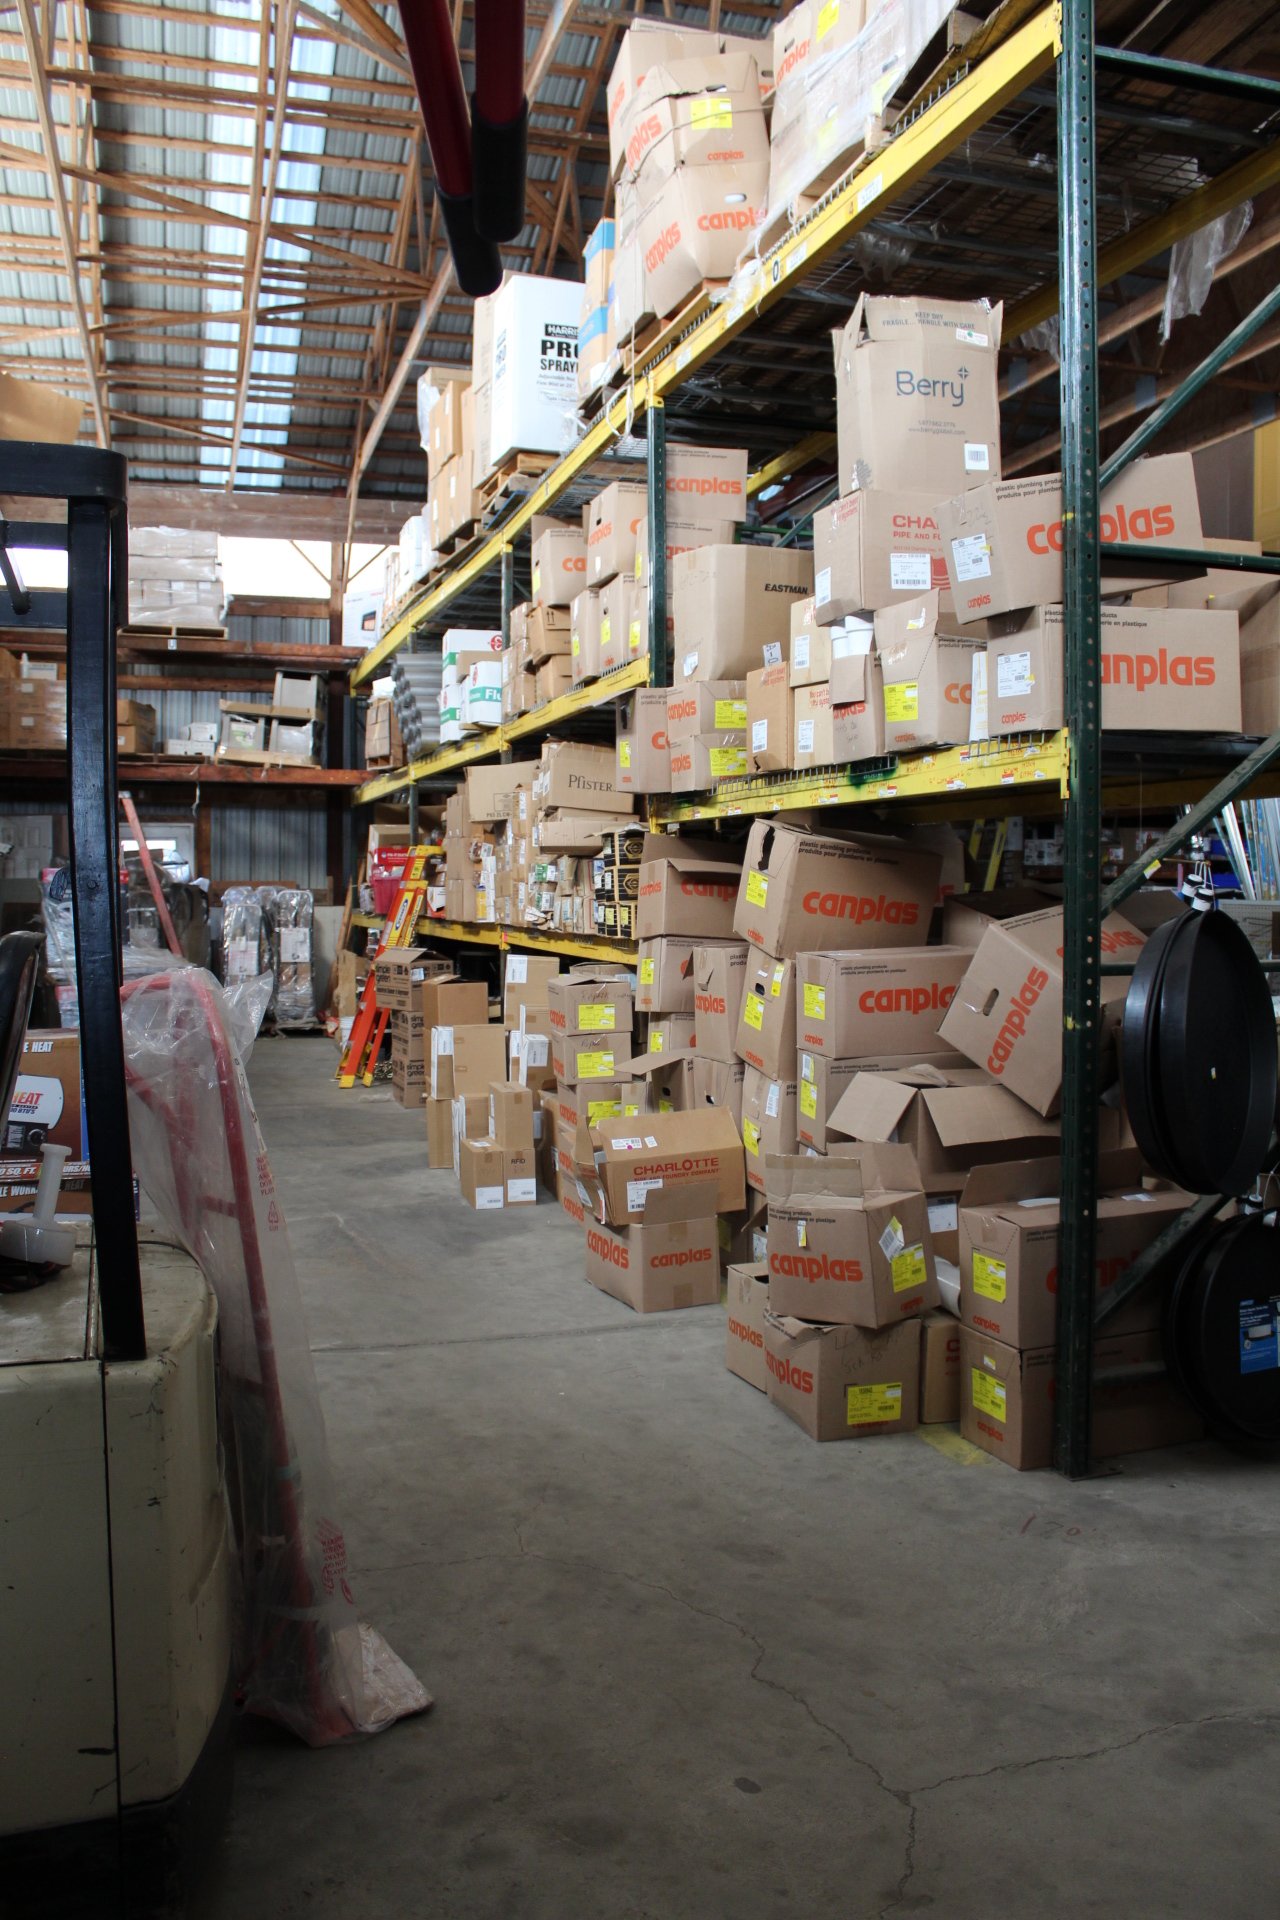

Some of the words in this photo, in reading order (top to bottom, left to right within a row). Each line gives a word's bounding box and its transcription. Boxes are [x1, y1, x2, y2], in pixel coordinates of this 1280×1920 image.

[707, 150, 744, 161] canplas
[915, 311, 930, 319] KEEP
[959, 322, 976, 330] CARE
[896, 370, 965, 408] Berry
[666, 477, 742, 496] canplas
[995, 484, 1016, 493] plastic
[1016, 480, 1043, 490] plumbing
[997, 491, 1022, 501] produits
[1023, 490, 1036, 499] pour
[893, 531, 911, 539] PIPE
[765, 584, 808, 594] EASTMAN
[968, 594, 991, 608] canplas
[1002, 711, 1026, 725] canplas
[798, 847, 822, 856] produits
[799, 841, 818, 849] plastic
[802, 891, 919, 925] canplas
[987, 966, 1049, 1076] canplas
[31, 1041, 54, 1053] HEAT
[804, 1033, 824, 1047] canplas
[633, 1157, 719, 1176] CHARLOTTE
[662, 1172, 689, 1181] FOUNDRY
[691, 1168, 719, 1177] COMPANY
[587, 1229, 629, 1269] canplas
[650, 1247, 712, 1268] canplas
[770, 1252, 864, 1283] canplas
[972, 1315, 1000, 1334] canplas
[728, 1316, 763, 1348] canplas
